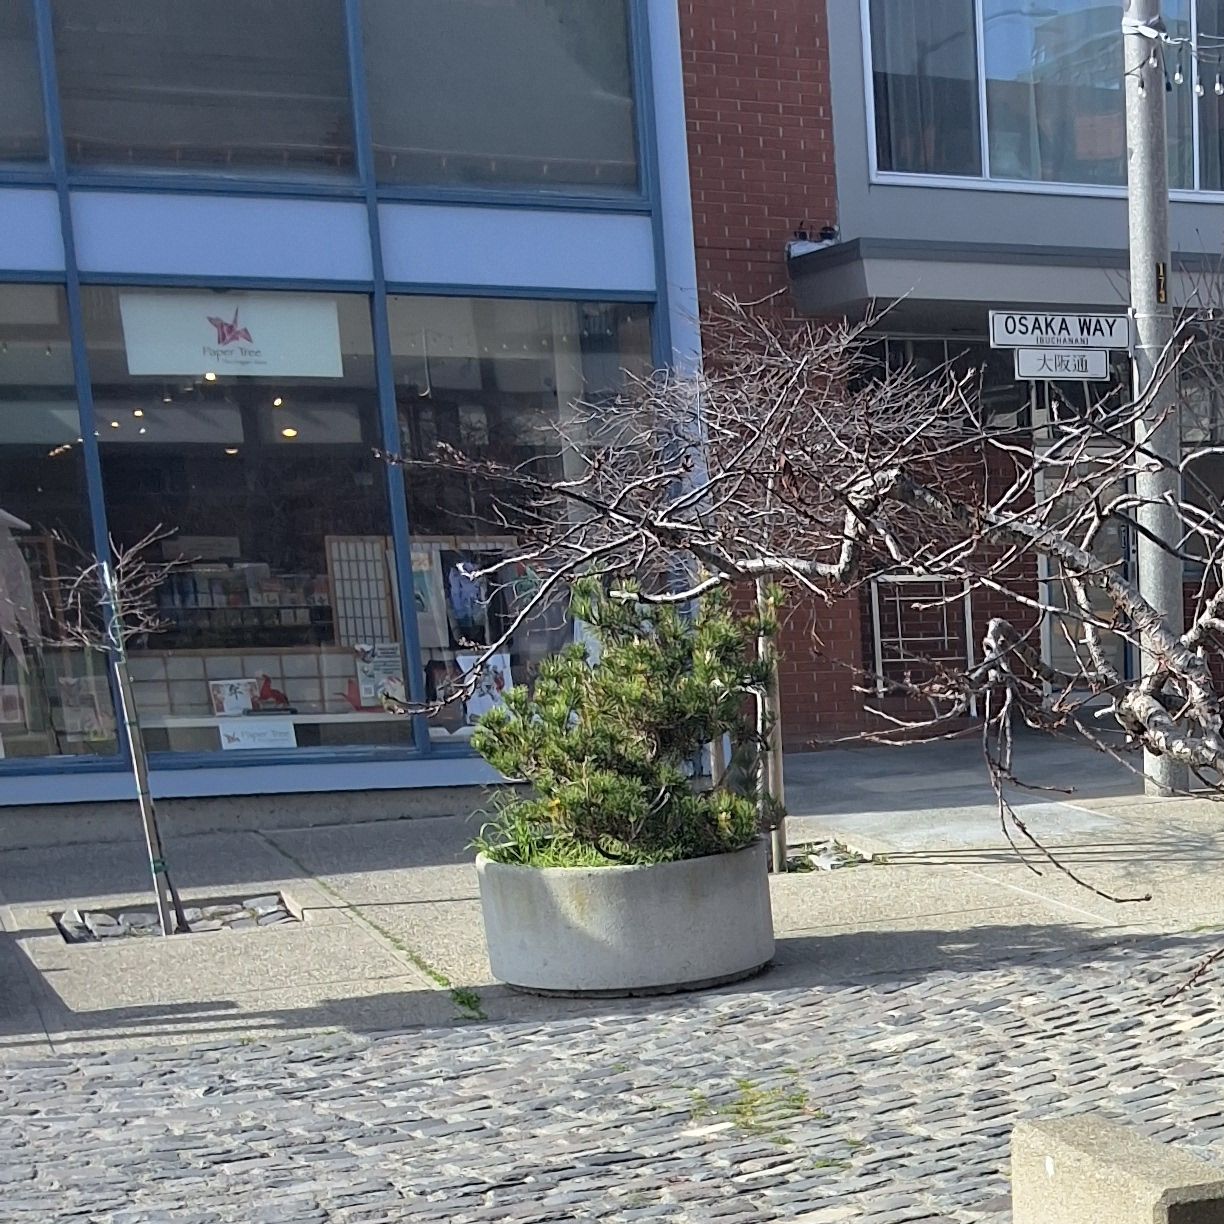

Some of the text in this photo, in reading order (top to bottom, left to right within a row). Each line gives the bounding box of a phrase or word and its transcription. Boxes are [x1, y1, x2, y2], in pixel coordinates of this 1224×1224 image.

[1005, 315, 1117, 337] OSAKA WAY
[238, 346, 262, 357] Tree
[1037, 353, 1089, 373] 大阪通
